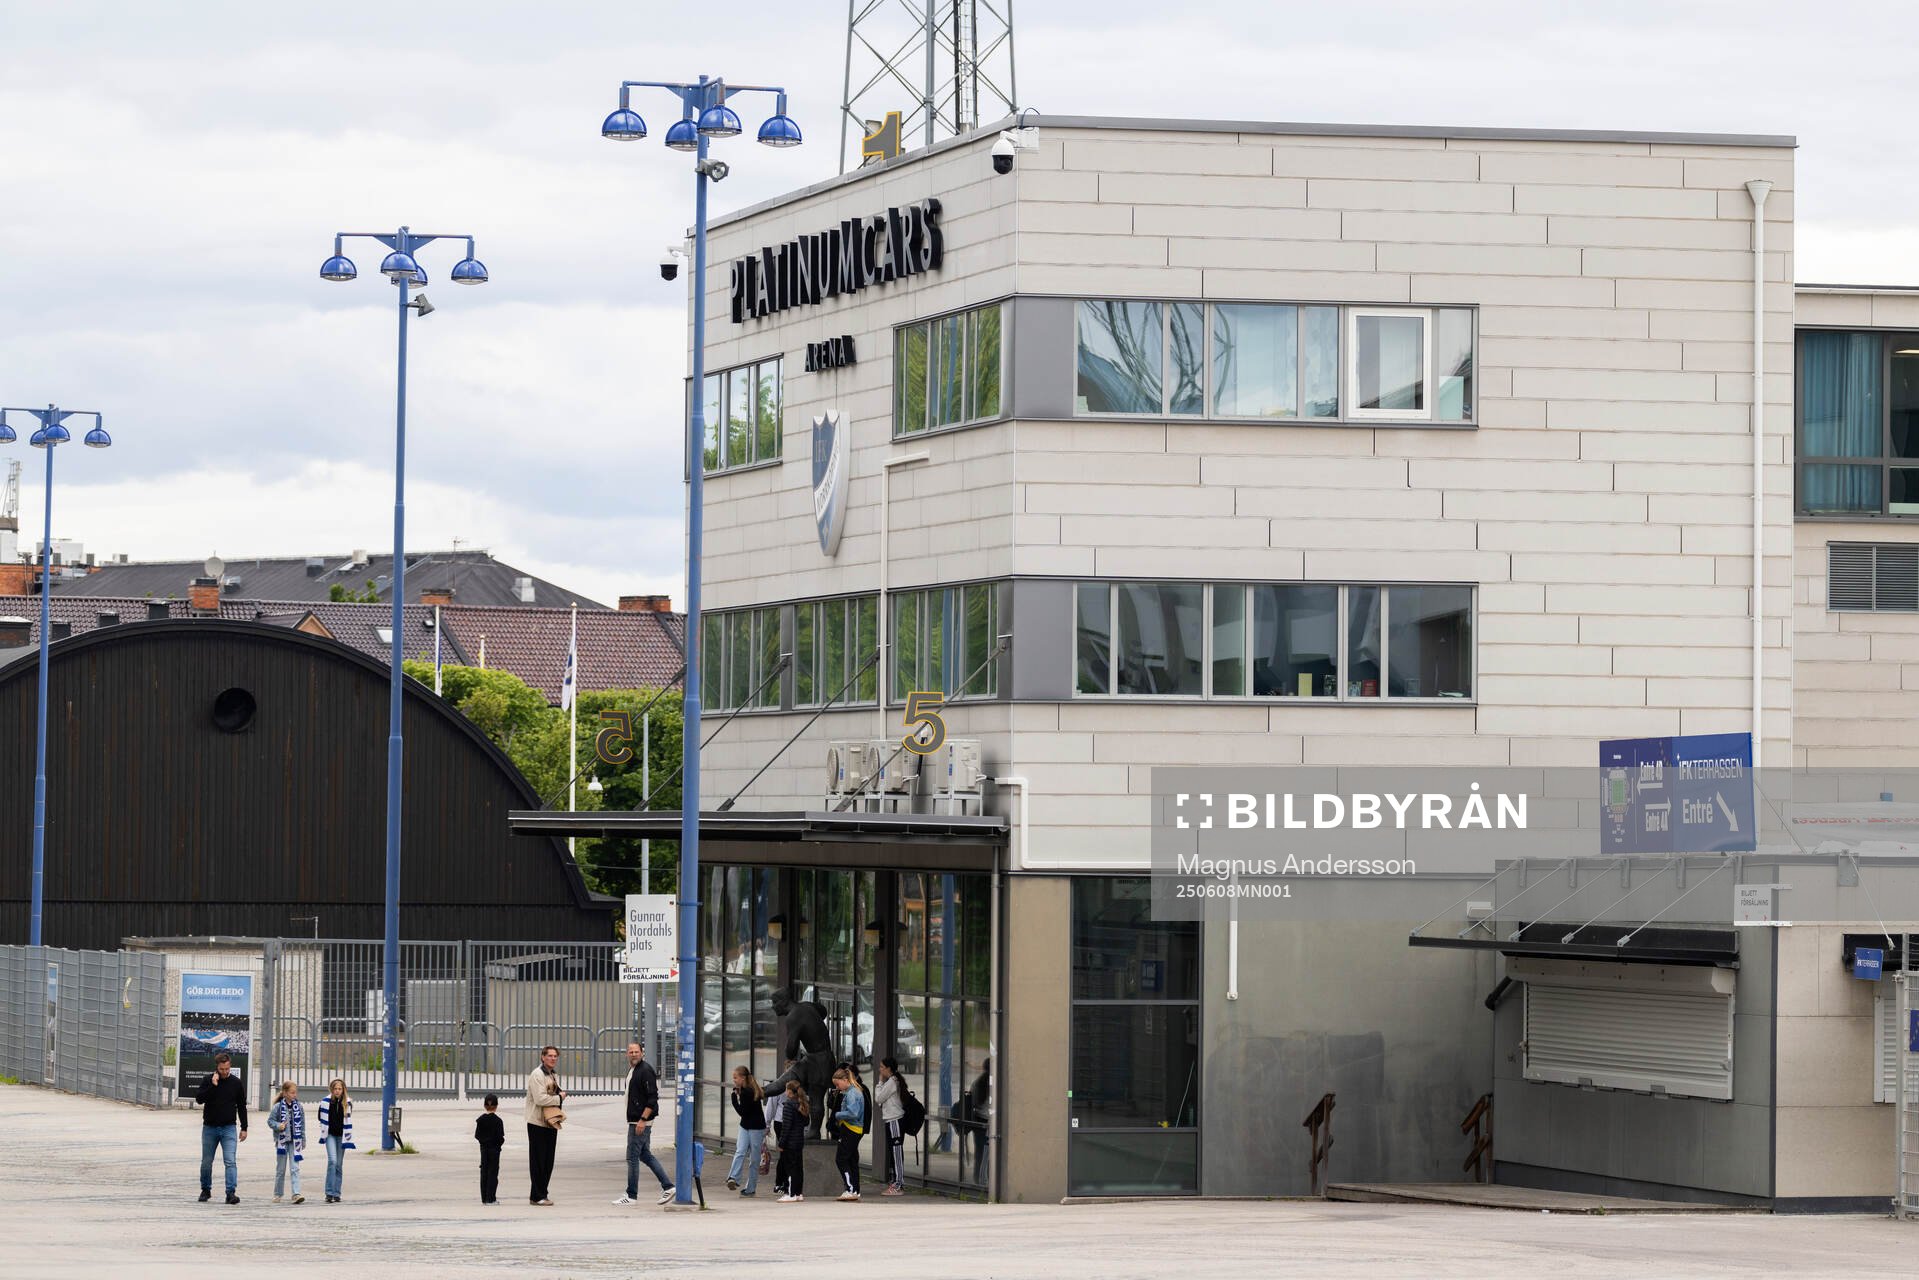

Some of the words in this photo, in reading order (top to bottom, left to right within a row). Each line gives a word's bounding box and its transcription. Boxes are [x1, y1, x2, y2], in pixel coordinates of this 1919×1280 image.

[730, 198, 943, 324] PLATINUMCARS
[804, 335, 854, 372] ARENA
[902, 692, 946, 755] 5
[1682, 796, 1714, 825] Entré
[630, 909, 666, 923] Gunnar
[629, 923, 672, 937] Nordahls
[630, 937, 653, 953] plats
[186, 986, 204, 995] GÖR
[204, 987, 220, 995] DIG
[221, 987, 244, 996] REDO
